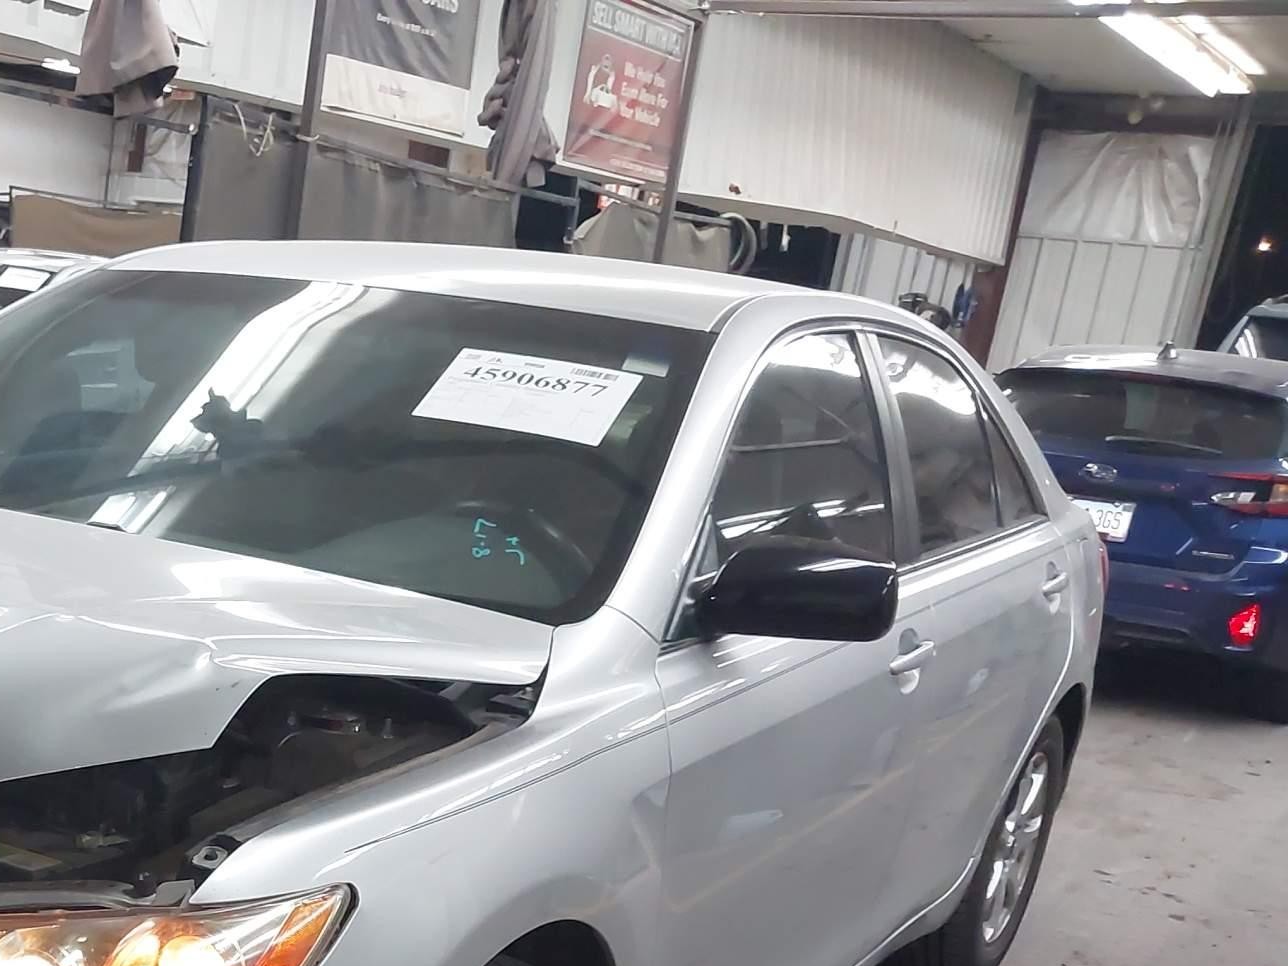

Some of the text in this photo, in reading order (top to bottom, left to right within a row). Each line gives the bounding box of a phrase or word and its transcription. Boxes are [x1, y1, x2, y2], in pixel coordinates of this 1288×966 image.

[593, 2, 612, 29] SELL
[614, 10, 645, 41] SMART
[463, 366, 609, 397] 45906877
